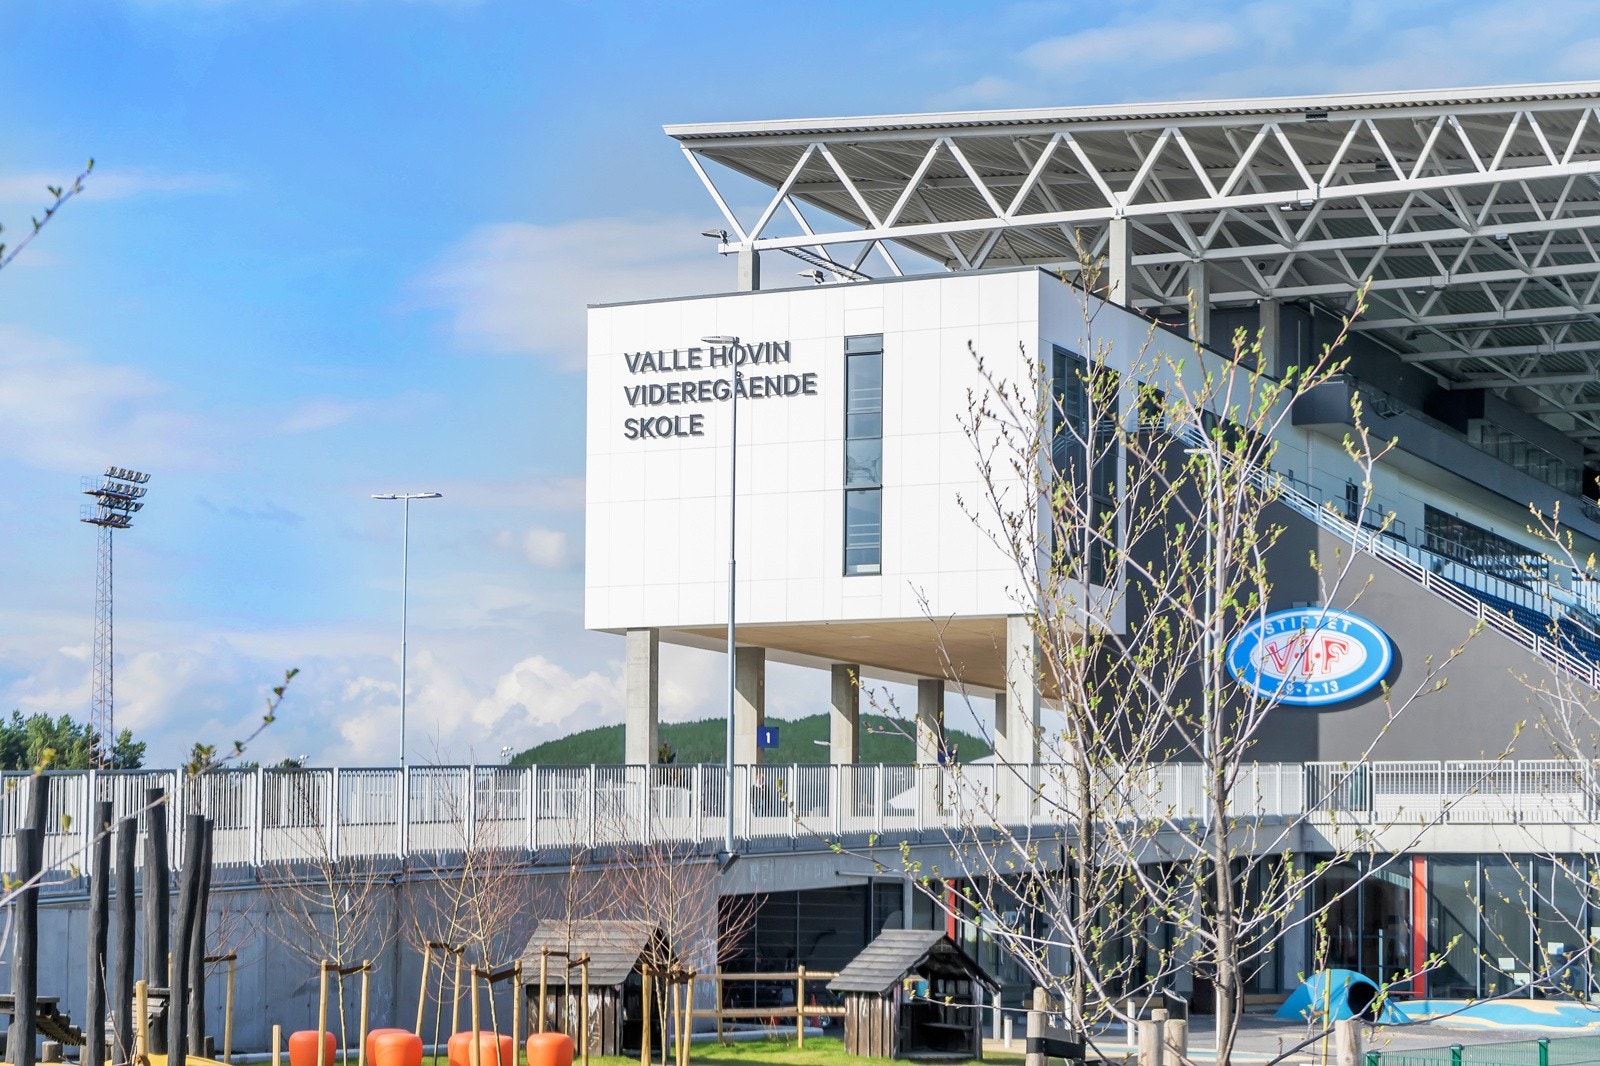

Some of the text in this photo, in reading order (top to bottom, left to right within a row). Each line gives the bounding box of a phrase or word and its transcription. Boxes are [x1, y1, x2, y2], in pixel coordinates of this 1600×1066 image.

[624, 340, 791, 373] VALLE HOVIN
[624, 371, 817, 406] VIDEREGÅENDE
[624, 413, 704, 440] SKOLE
[1265, 615, 1352, 635] STIFTET
[765, 731, 771, 744] 1
